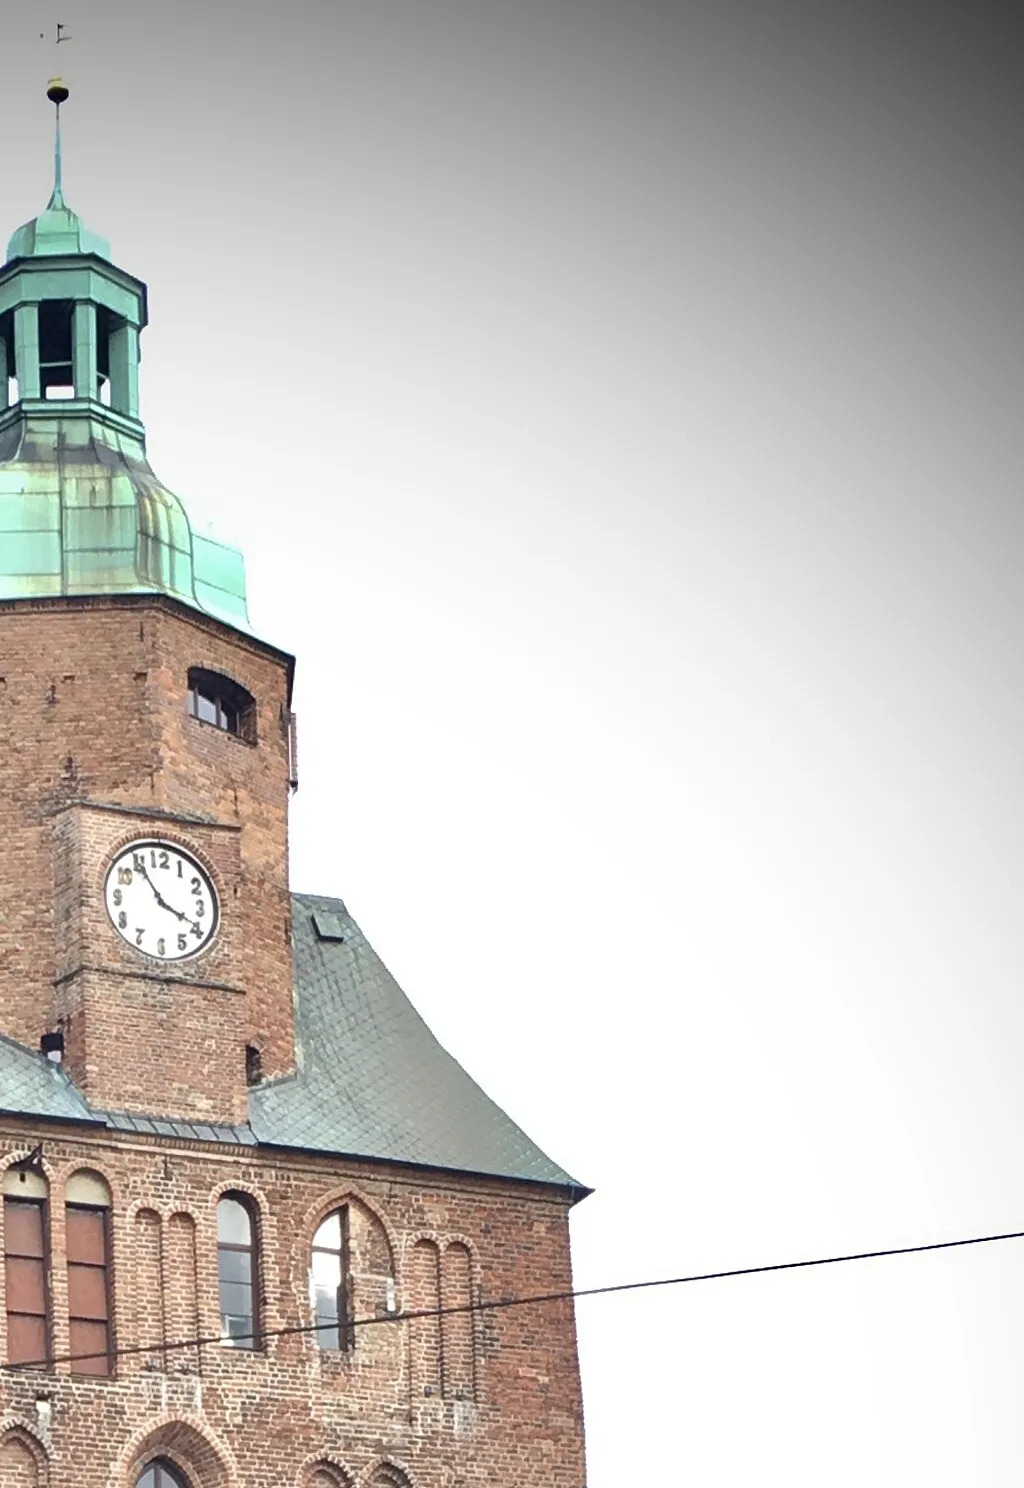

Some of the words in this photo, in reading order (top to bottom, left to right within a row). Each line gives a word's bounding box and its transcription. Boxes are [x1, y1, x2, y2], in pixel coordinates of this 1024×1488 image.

[150, 850, 170, 869] 12
[118, 867, 133, 885] 10
[177, 860, 183, 878] 1
[191, 878, 202, 896] 2
[113, 889, 122, 906] 9
[196, 900, 204, 917] 3
[118, 911, 127, 929] 8
[136, 929, 146, 945] 7
[190, 922, 204, 939] 4
[157, 938, 165, 956] 6
[178, 934, 187, 951] 5
